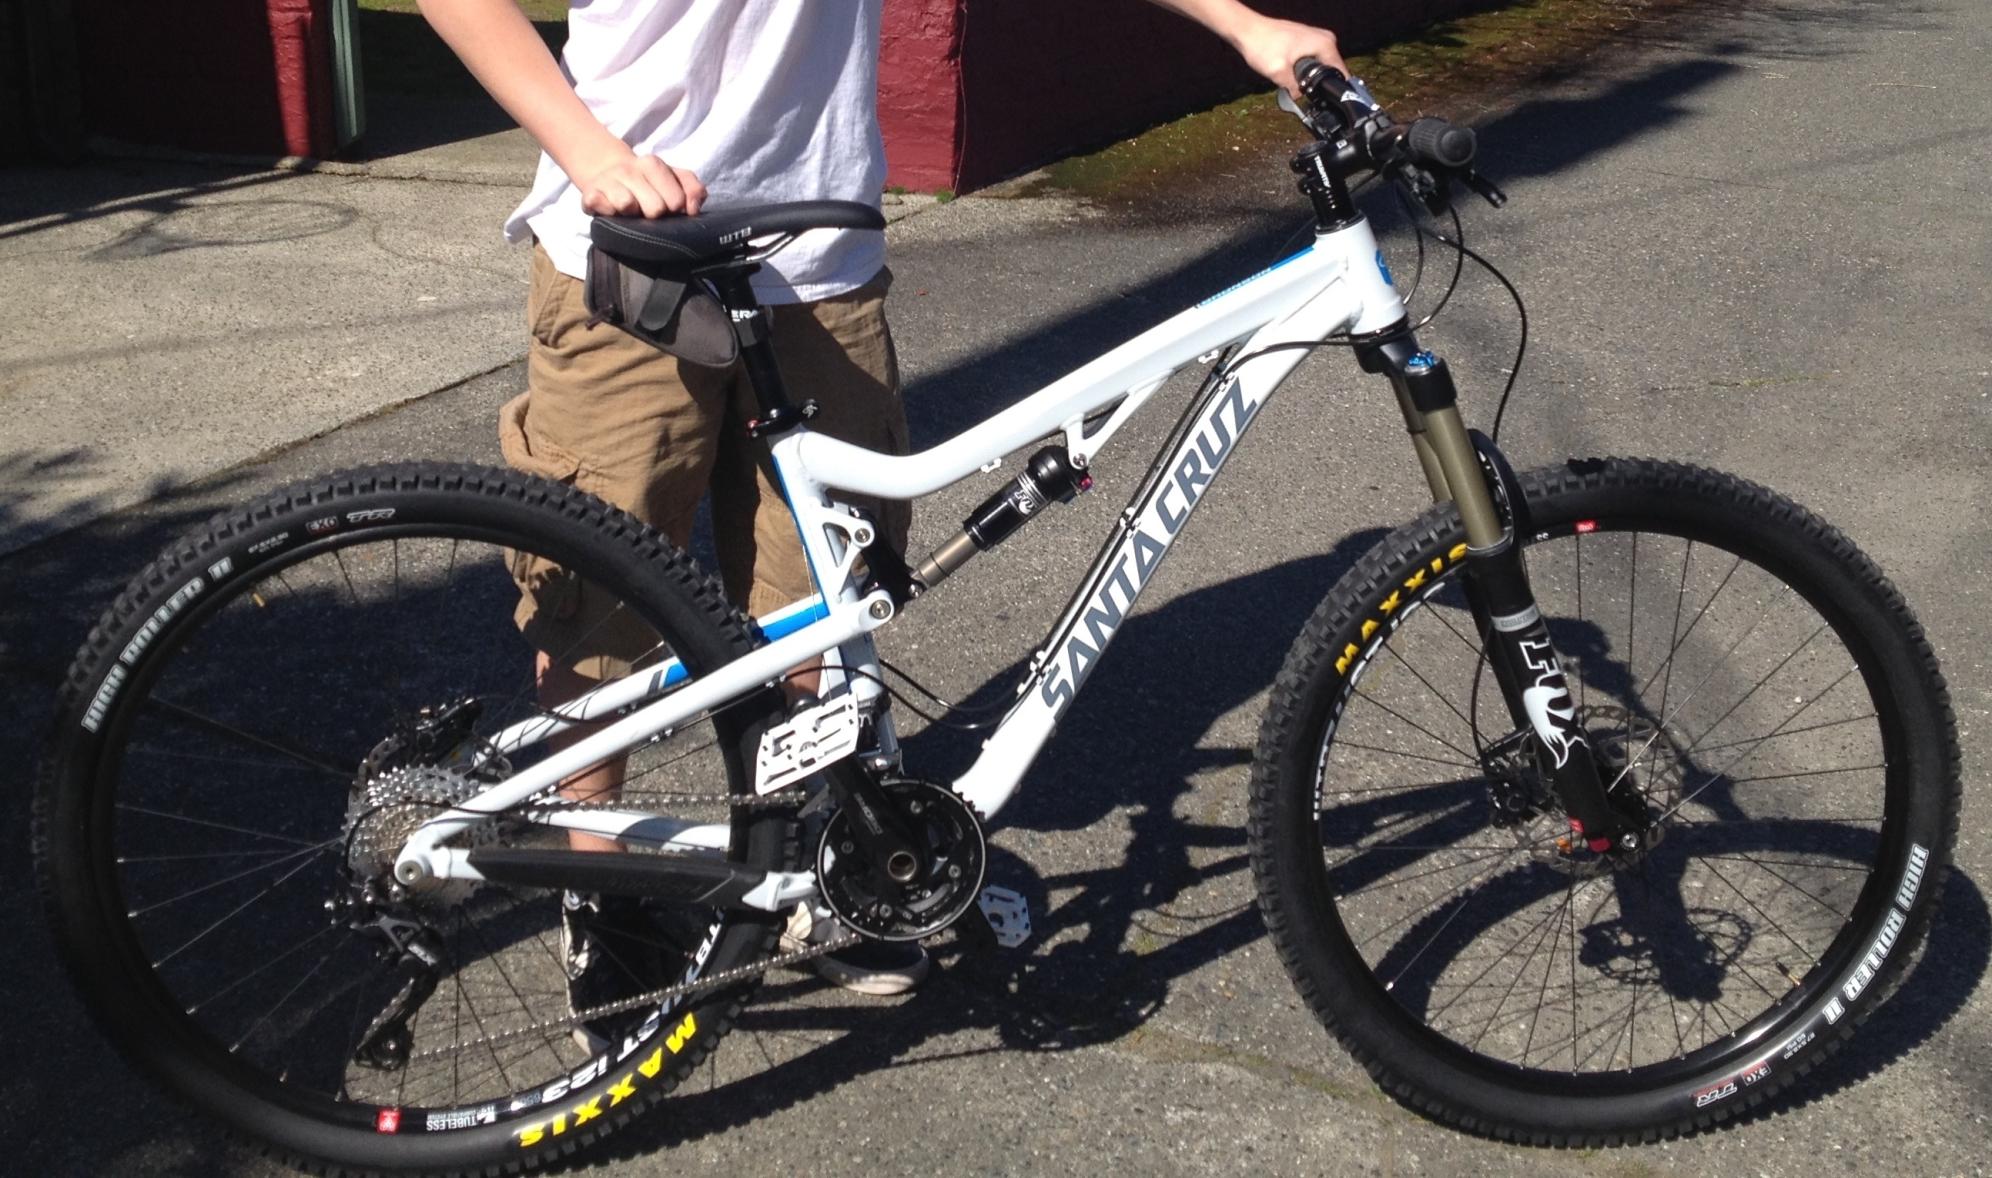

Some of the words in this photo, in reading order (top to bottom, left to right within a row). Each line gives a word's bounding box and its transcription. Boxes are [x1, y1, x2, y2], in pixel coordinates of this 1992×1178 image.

[719, 226, 752, 244] WTB
[1041, 530, 1166, 711] SANTA
[1155, 377, 1258, 535] CRUZ
[81, 664, 127, 733] HIGH
[119, 577, 204, 666] ROLLER
[1896, 843, 1929, 911] HIGH
[1843, 907, 1906, 1001] ROLLER
[1822, 997, 1845, 1025] II
[520, 1013, 697, 1147] MAXXIS
[426, 1116, 479, 1132] TUBELESS
